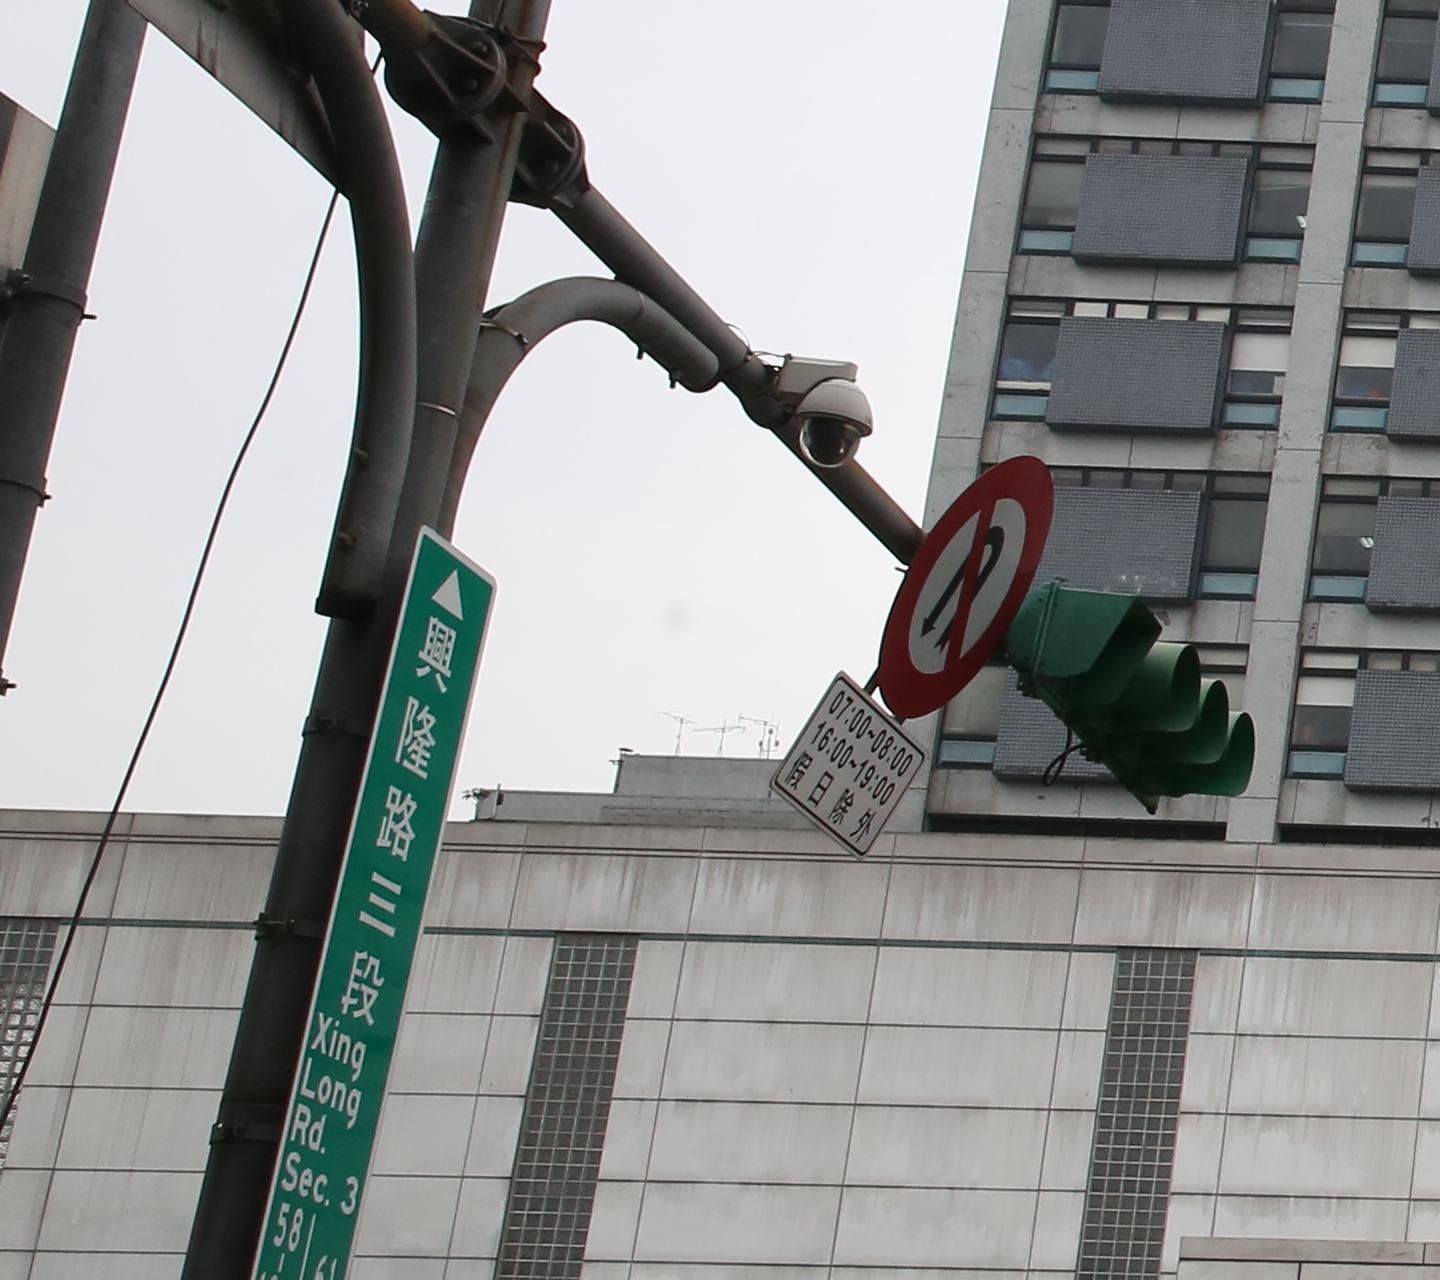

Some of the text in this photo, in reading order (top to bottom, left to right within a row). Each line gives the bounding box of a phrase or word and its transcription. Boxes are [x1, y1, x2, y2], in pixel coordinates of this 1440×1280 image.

[811, 721, 897, 807] 16:00~19:00
[828, 689, 914, 778] 07:00~08:00
[340, 615, 456, 1026] 興隆路三段
[785, 750, 874, 843] 假日除外
[311, 1012, 367, 1082] Xing
[290, 1103, 328, 1154] Rd.
[301, 1057, 362, 1129] Long
[281, 1151, 359, 1215] Sec. 3
[273, 1202, 304, 1252] 58
